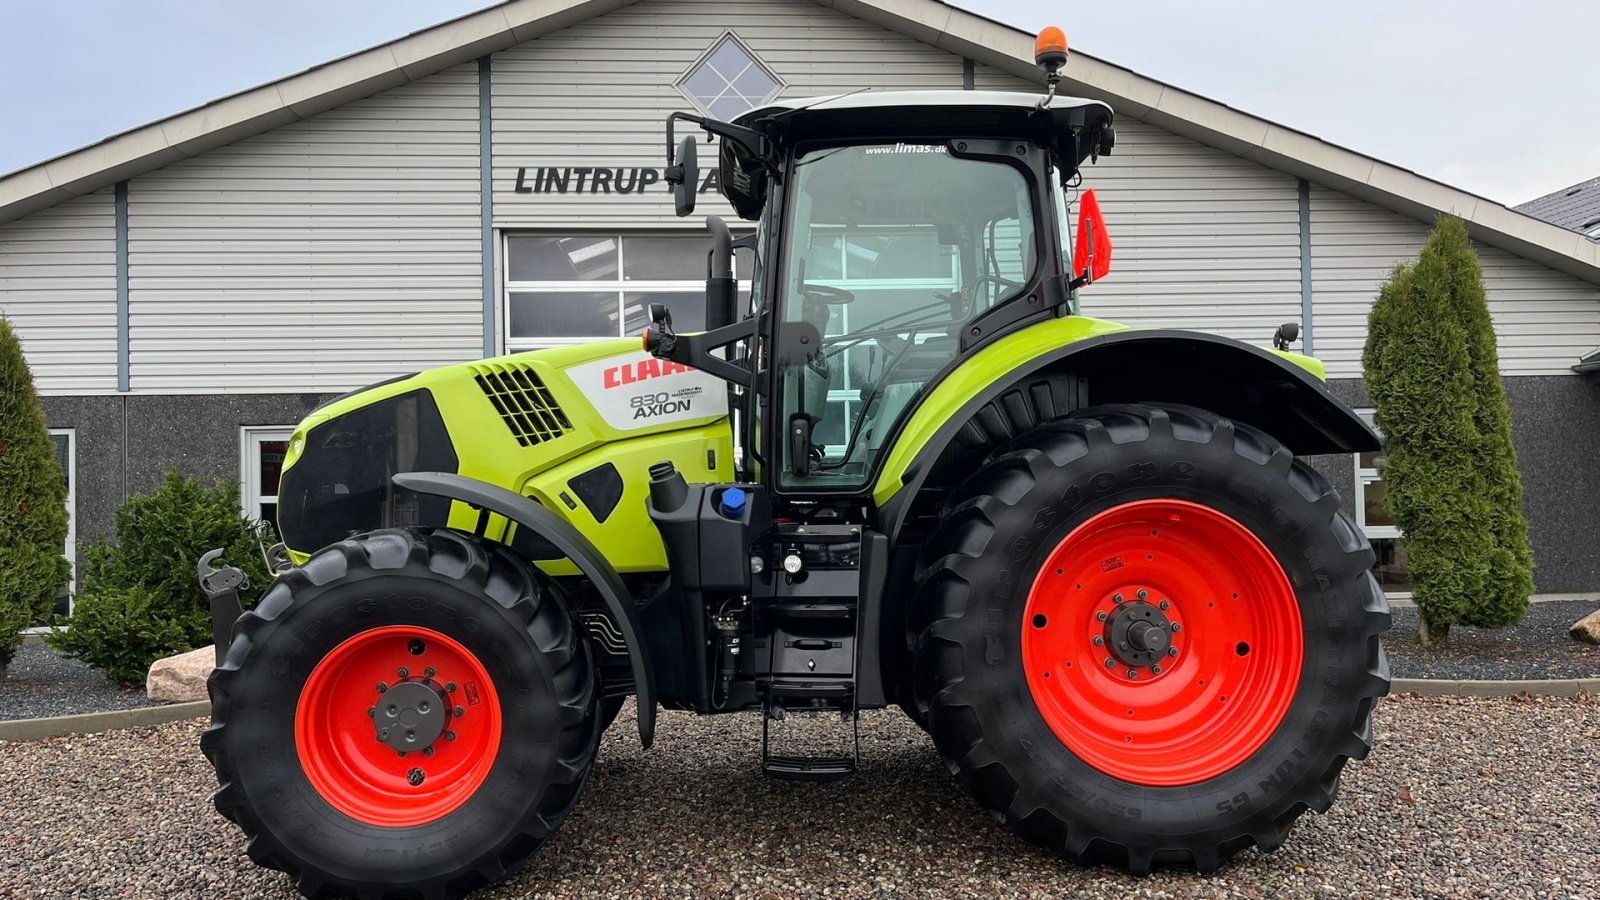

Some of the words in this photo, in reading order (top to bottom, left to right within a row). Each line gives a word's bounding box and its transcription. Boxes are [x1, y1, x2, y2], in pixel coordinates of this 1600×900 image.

[865, 142, 947, 155] www.limas.dk
[514, 167, 659, 194] LINTRUP
[603, 358, 698, 390] CLAA
[630, 391, 670, 409] 830
[633, 399, 691, 420] AXION
[984, 460, 1195, 666] Firestone
